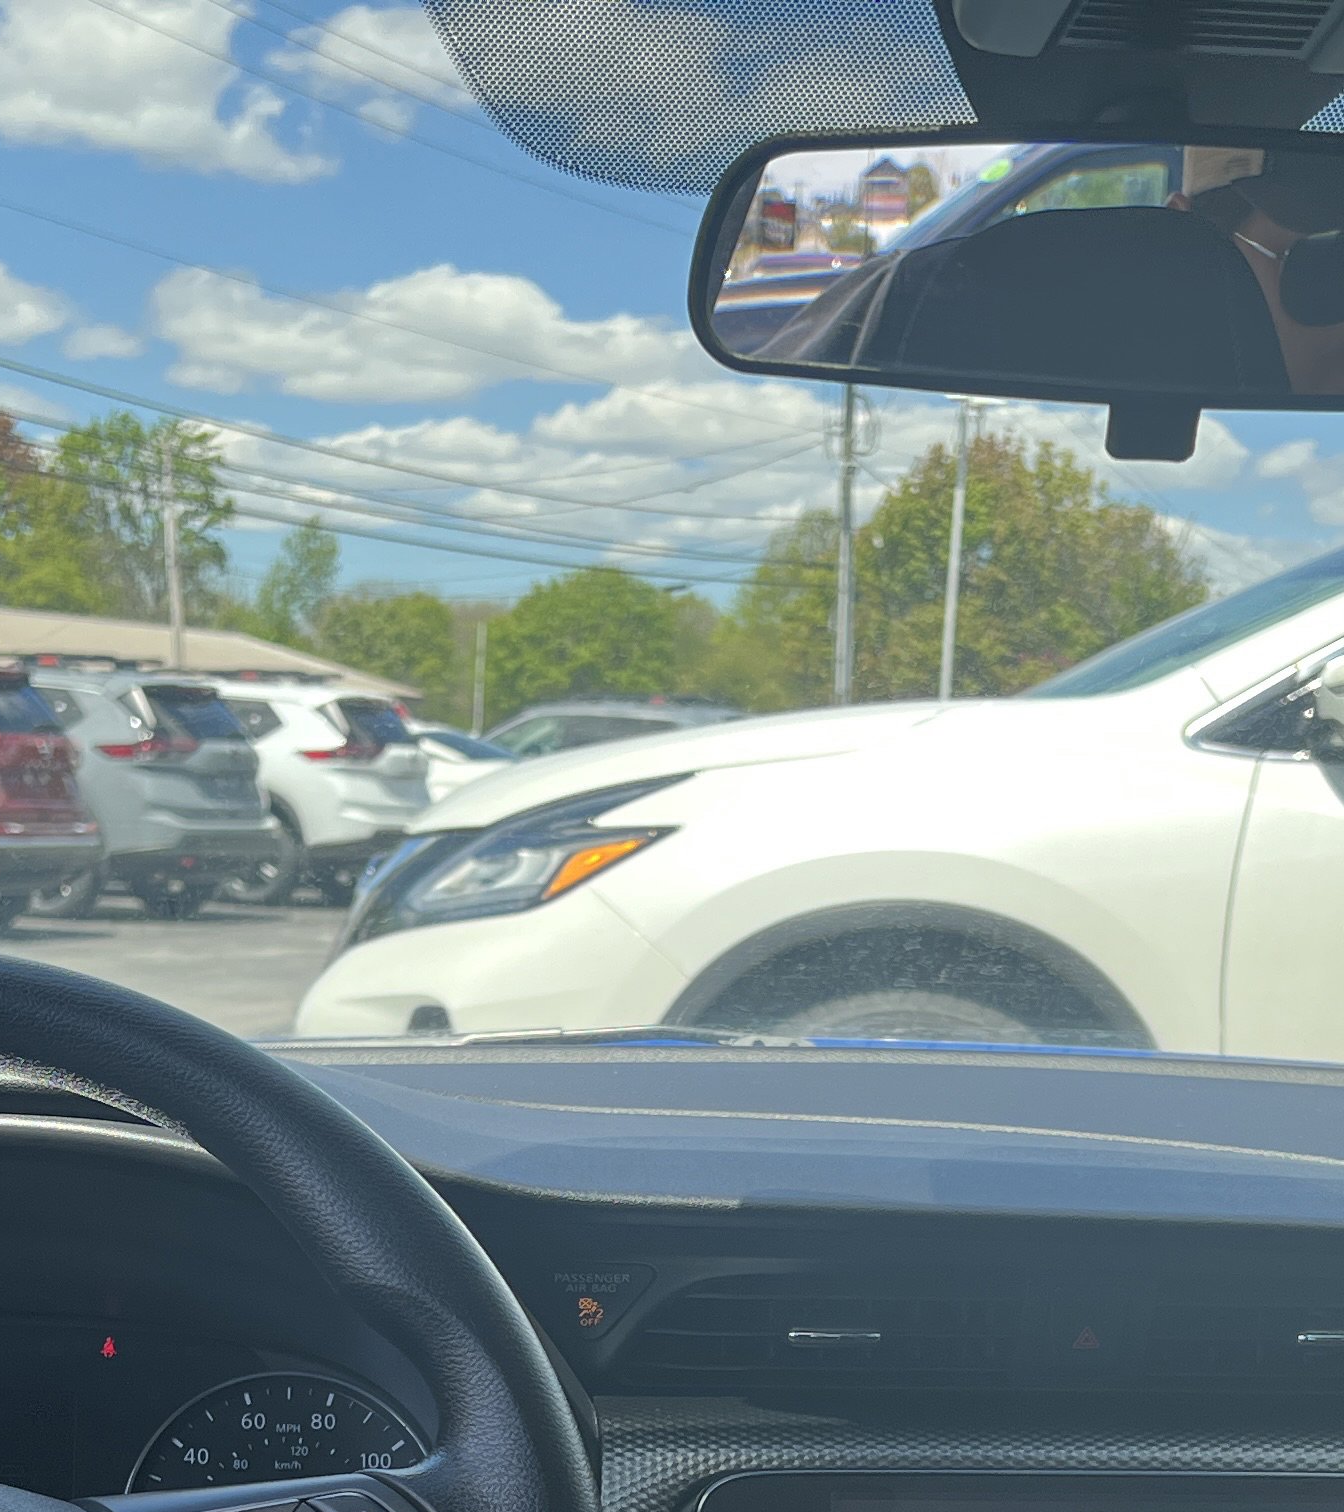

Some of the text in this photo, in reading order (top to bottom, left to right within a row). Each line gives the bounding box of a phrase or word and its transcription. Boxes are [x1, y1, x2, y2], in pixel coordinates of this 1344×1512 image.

[554, 1272, 631, 1283] PASSENGER
[565, 1283, 617, 1293] AIR BAG
[580, 1318, 601, 1327] OFF
[241, 1413, 266, 1430] 60
[310, 1413, 336, 1430] 80
[275, 1424, 301, 1434] MPH
[183, 1448, 209, 1465] 40
[290, 1446, 309, 1457] 120
[233, 1459, 248, 1470] 80
[274, 1460, 302, 1470] km/h
[359, 1453, 392, 1469] 100
